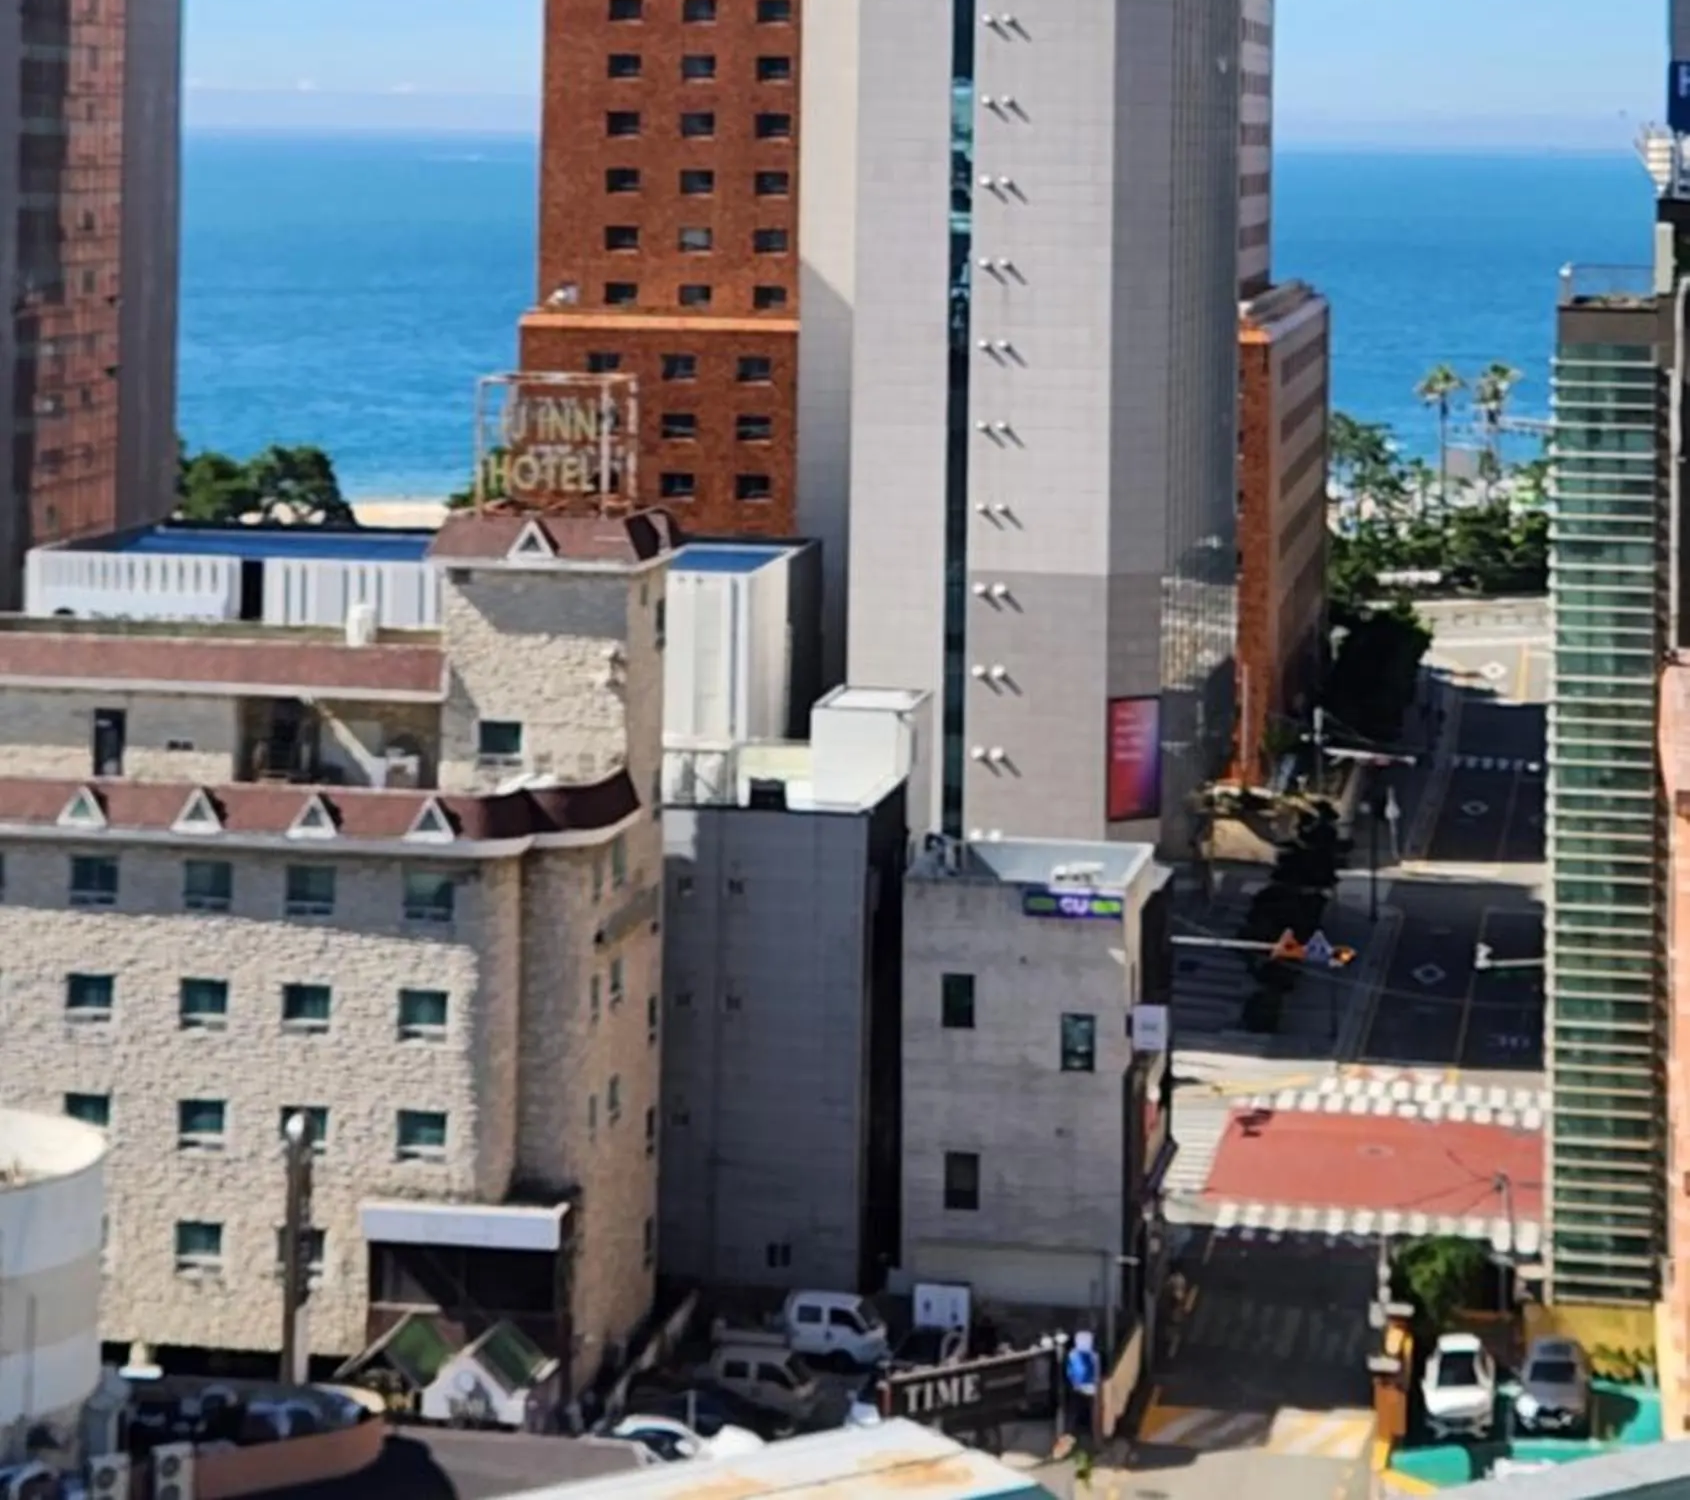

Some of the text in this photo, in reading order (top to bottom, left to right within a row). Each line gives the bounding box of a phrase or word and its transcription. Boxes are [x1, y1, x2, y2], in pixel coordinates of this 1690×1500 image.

[537, 399, 597, 442] INN
[488, 453, 595, 493] HOTEL
[902, 1372, 982, 1414] TIME
